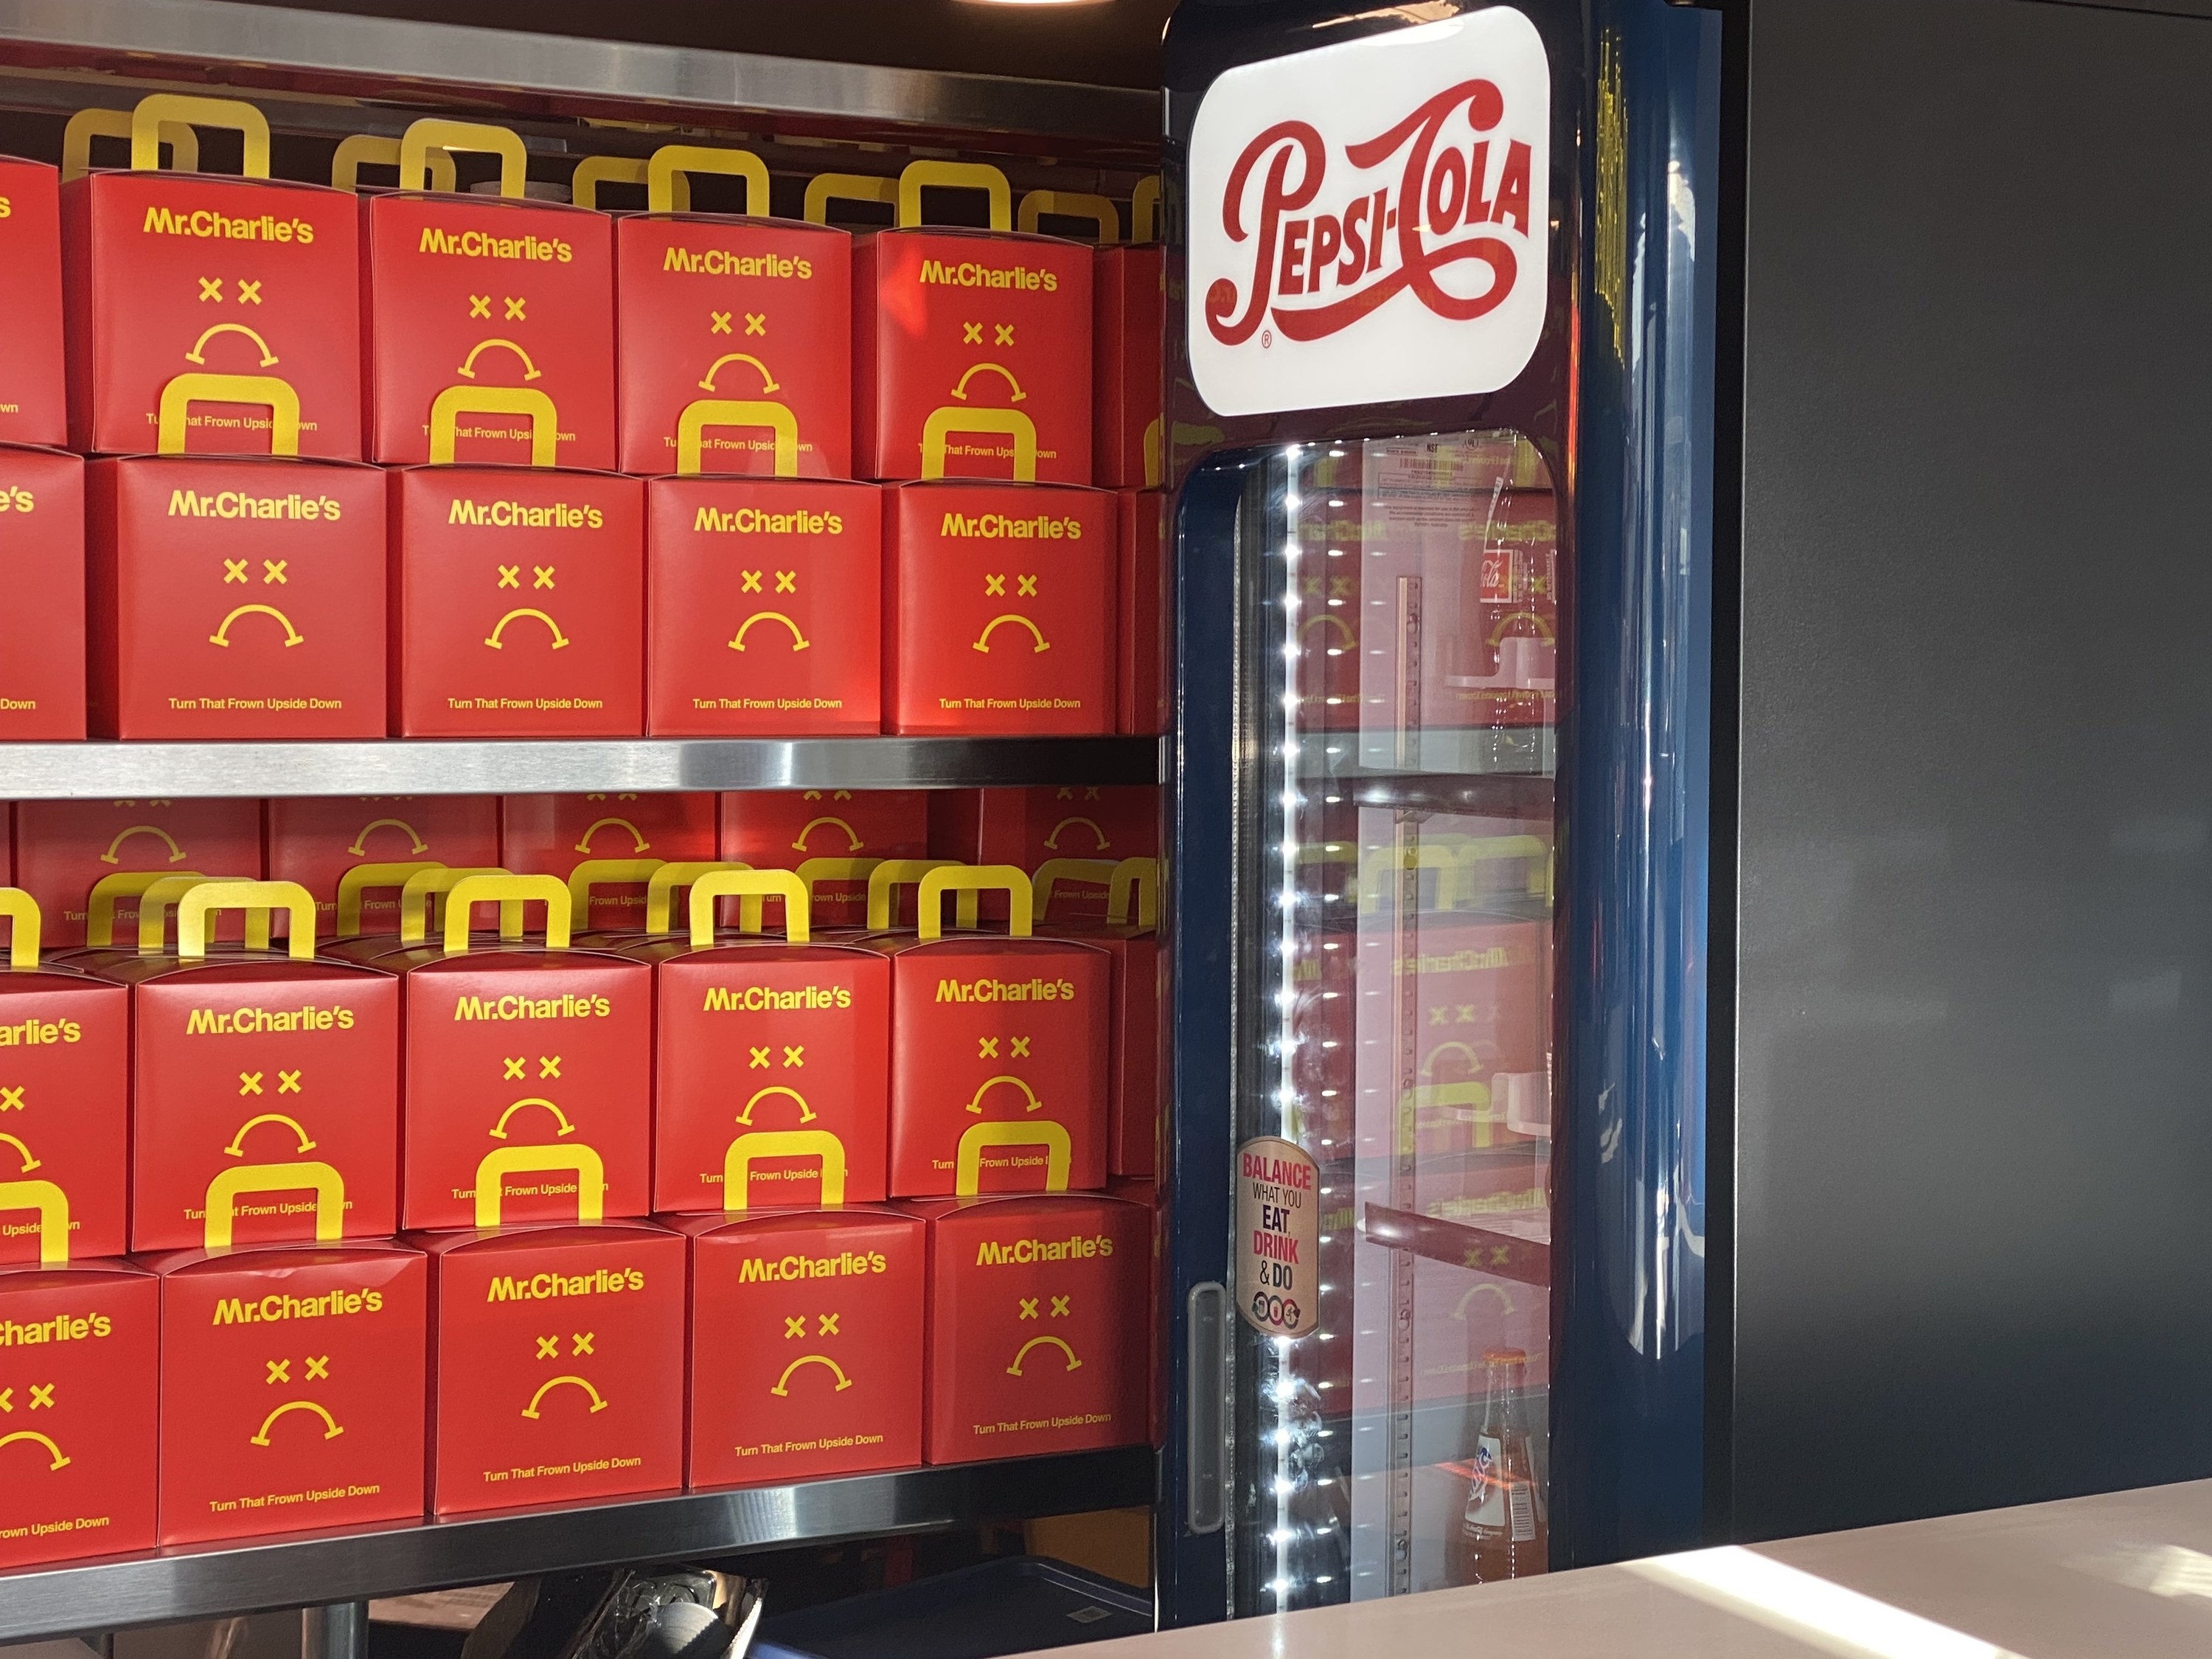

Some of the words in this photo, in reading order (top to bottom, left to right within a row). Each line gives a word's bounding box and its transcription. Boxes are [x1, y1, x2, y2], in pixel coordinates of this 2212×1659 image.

[144, 207, 313, 243] Mr.Charlie's
[420, 228, 572, 262] Mr.Charlie's
[664, 248, 812, 279] Mr.Charlie's
[919, 260, 1057, 291] Mr.Charlie's
[204, 416, 240, 428] Frown
[454, 426, 472, 437] hat
[474, 427, 507, 439] Frown
[509, 428, 532, 442] Upsi
[556, 432, 576, 442] own
[714, 439, 745, 450] Frown
[797, 443, 813, 452] wn
[965, 445, 994, 456] Frown
[996, 446, 1014, 459] Ups
[1036, 450, 1057, 459] own
[168, 490, 341, 521] Mr.Charlie's
[448, 500, 602, 528] Mr.Charlie's
[695, 507, 842, 534] Mr.Charlie's
[941, 513, 1081, 539] Mr.Charlie's
[169, 698, 196, 709] Turn
[199, 698, 226, 709] That
[228, 698, 264, 709] Frown
[267, 698, 307, 712] Upside
[310, 698, 342, 709] Down
[448, 698, 473, 709] Turn
[475, 698, 498, 709] That
[501, 698, 533, 709] Frown
[535, 698, 571, 711] Upside
[574, 698, 603, 709] Down
[693, 698, 717, 709] Turn
[719, 698, 741, 709] That
[743, 698, 775, 709] Frown
[777, 698, 812, 711] Upside
[813, 698, 842, 709] Down
[939, 698, 961, 709] Turn
[964, 698, 985, 709] That
[987, 698, 1017, 709] Frown
[1019, 698, 1052, 711] Upside
[1054, 698, 1081, 709] Down
[364, 900, 396, 910] Frown
[589, 896, 619, 905] Frown
[620, 896, 647, 906] Upsid
[703, 986, 851, 1010] Mr.Charlie's
[936, 979, 1074, 1002] Mr.Charlie's
[187, 1006, 354, 1034] Mr.Charlie's
[454, 994, 610, 1020] Mr.Charlie's
[0, 1018, 81, 1047] arlie's
[932, 1159, 954, 1169] Turn
[979, 1157, 1009, 1168] Frown
[1011, 1155, 1044, 1169] Upside
[1242, 1152, 1312, 1190] BALANCE
[700, 1173, 723, 1183] Turn
[750, 1171, 782, 1181] Frown
[783, 1169, 818, 1181] Upside
[451, 1188, 476, 1199] Turn
[505, 1185, 538, 1196] Frown
[540, 1183, 577, 1196] Upside
[1253, 1182, 1280, 1203] WHAT
[1282, 1189, 1301, 1208] YOU
[241, 1205, 276, 1217] Frown
[976, 1235, 1113, 1265] Mr.Charlie's
[1253, 1230, 1298, 1265] DRINK
[739, 1251, 886, 1283] Mr.Charlie's
[1259, 1260, 1270, 1285] &
[1273, 1262, 1293, 1290] DO
[487, 1268, 644, 1301] Mr.Charlie's
[213, 1288, 382, 1325] Mr.Charlie's
[0, 1312, 111, 1346] harlie's
[973, 1425, 995, 1435] Turn
[997, 1422, 1018, 1432] That
[1020, 1419, 1049, 1430] Frown
[1051, 1415, 1084, 1429] Upside
[1085, 1413, 1111, 1423] Down
[734, 1447, 759, 1457] Turn
[760, 1444, 783, 1454] That
[785, 1441, 816, 1453] Frown
[818, 1436, 853, 1451] Upside
[855, 1433, 884, 1445] Down
[483, 1471, 509, 1482] Turn
[510, 1468, 535, 1480] That
[537, 1465, 571, 1477] Frown
[573, 1460, 609, 1475] Upside
[611, 1456, 641, 1469] Down
[209, 1501, 237, 1512] Turn
[239, 1497, 265, 1509] That
[267, 1493, 304, 1506] Frown
[306, 1488, 346, 1503] Upside
[347, 1484, 380, 1497] Down
[31, 1520, 73, 1537] Upside
[75, 1517, 110, 1530] Down
